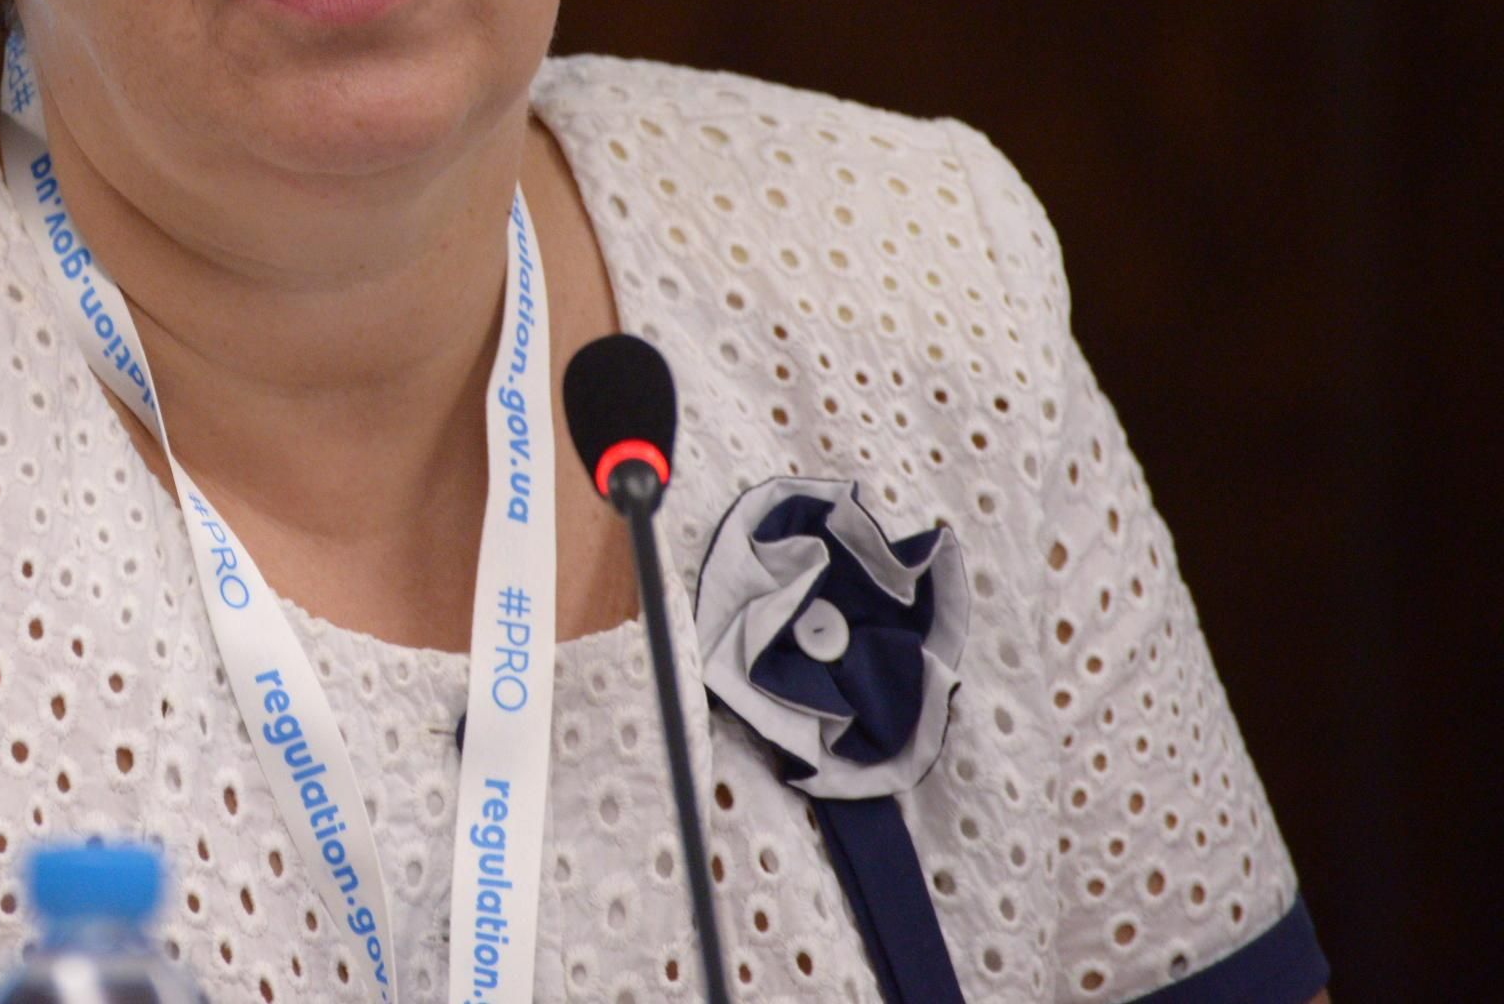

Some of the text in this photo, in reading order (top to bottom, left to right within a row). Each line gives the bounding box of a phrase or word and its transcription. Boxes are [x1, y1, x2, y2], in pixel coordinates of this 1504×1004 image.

[30, 153, 158, 414] lation.gov.ua
[188, 492, 250, 610] #PRO
[469, 196, 534, 1004] gulation.gov.ua #PRO regulation.
